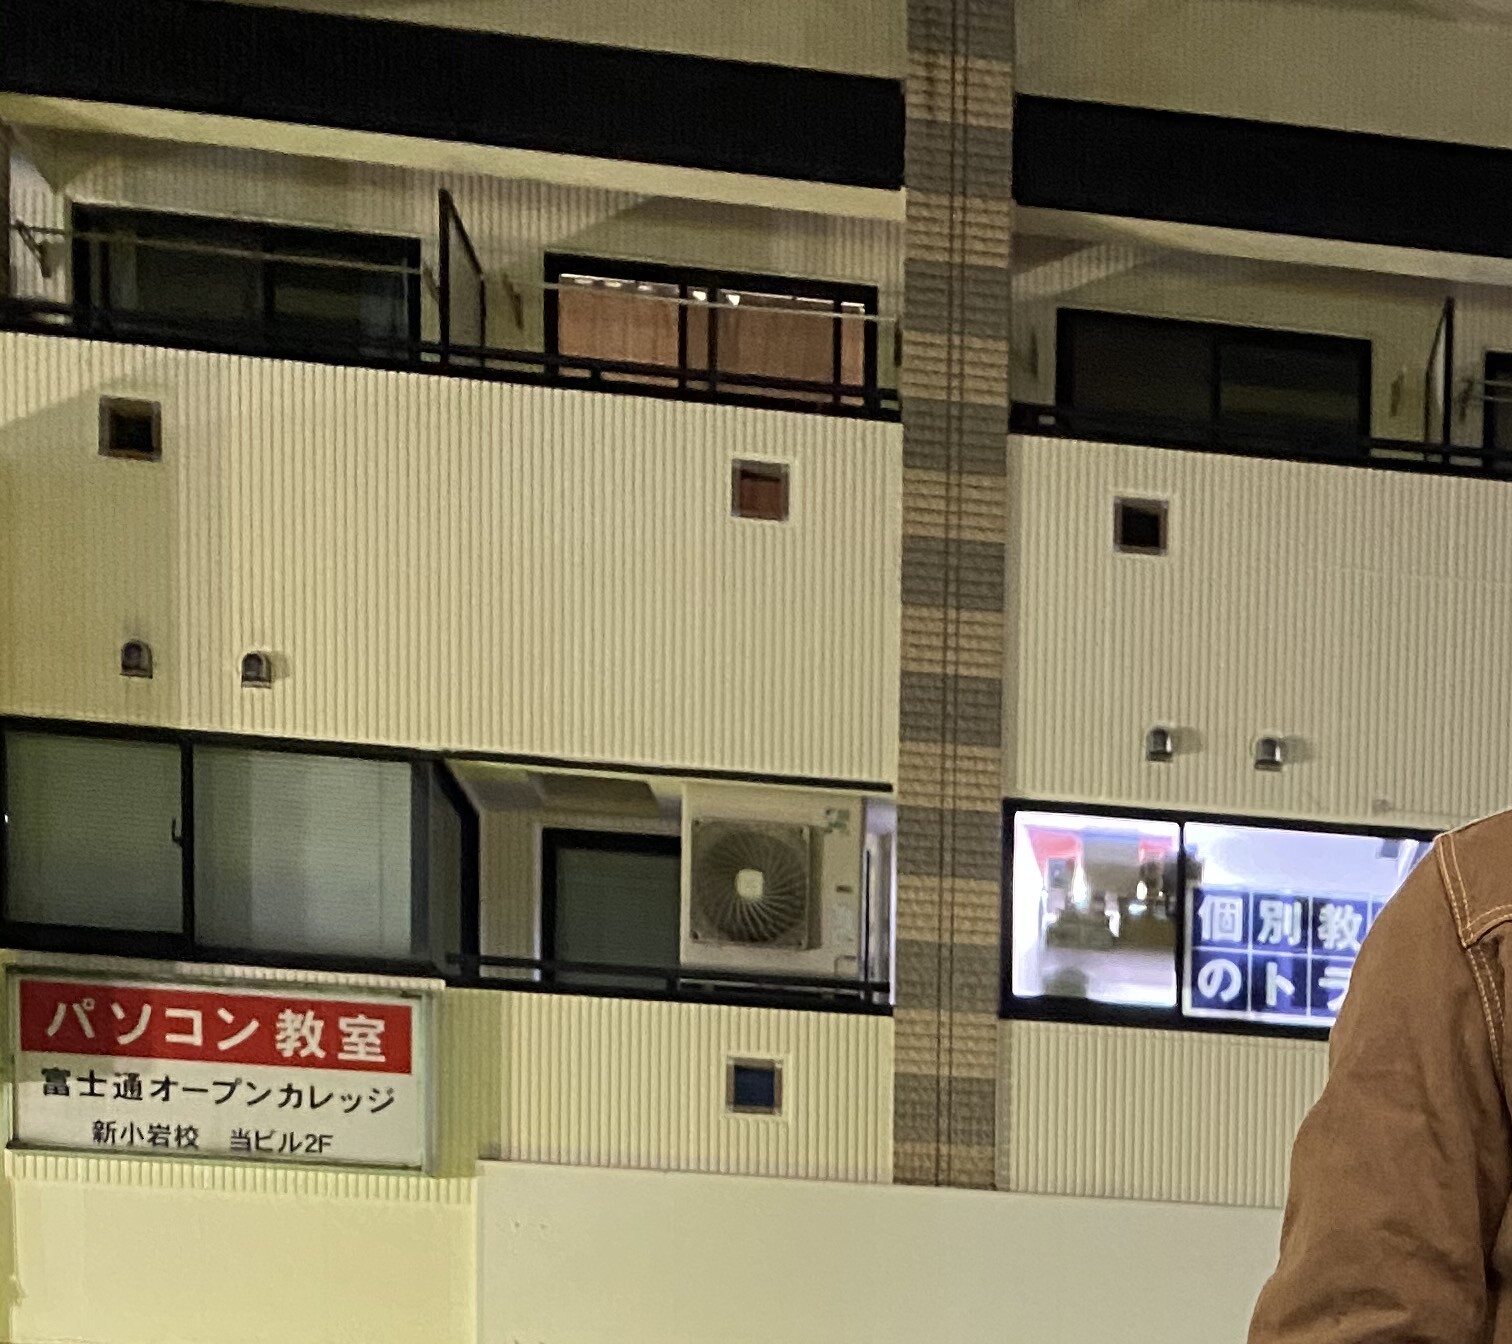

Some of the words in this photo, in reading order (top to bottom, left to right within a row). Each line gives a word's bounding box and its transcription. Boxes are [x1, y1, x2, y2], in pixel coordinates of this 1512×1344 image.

[46, 997, 388, 1064] パソコン教室
[41, 1067, 396, 1115] 富士通オープンカレッジ
[91, 1119, 200, 1150] 新小岩校
[229, 1127, 334, 1155] 当ビル2F
